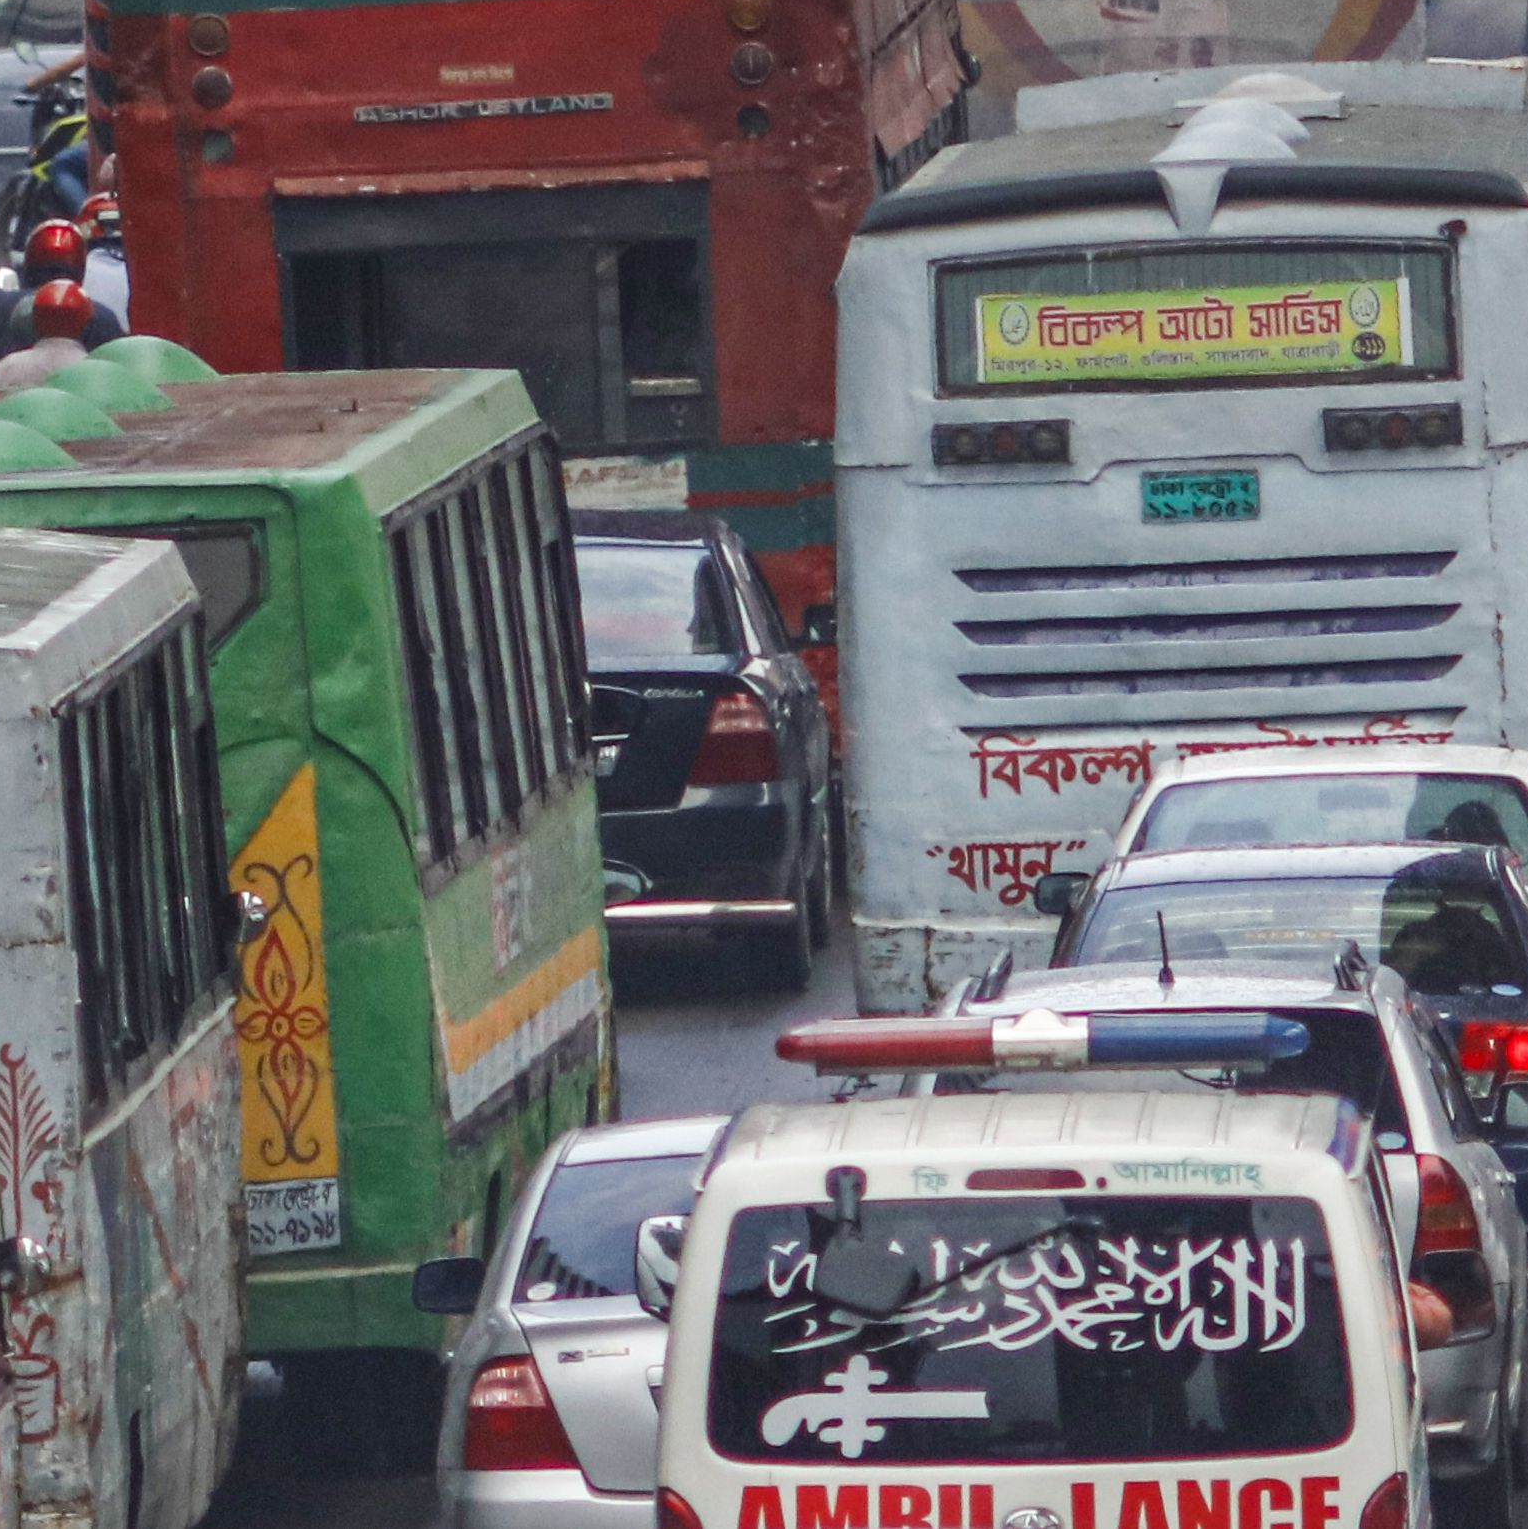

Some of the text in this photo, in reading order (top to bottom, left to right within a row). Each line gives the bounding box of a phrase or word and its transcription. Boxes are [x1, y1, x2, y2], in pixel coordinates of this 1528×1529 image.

[1037, 290, 1342, 348] বিকল্প অটো সার্ভিস
[970, 731, 1157, 799] বিকল্প
